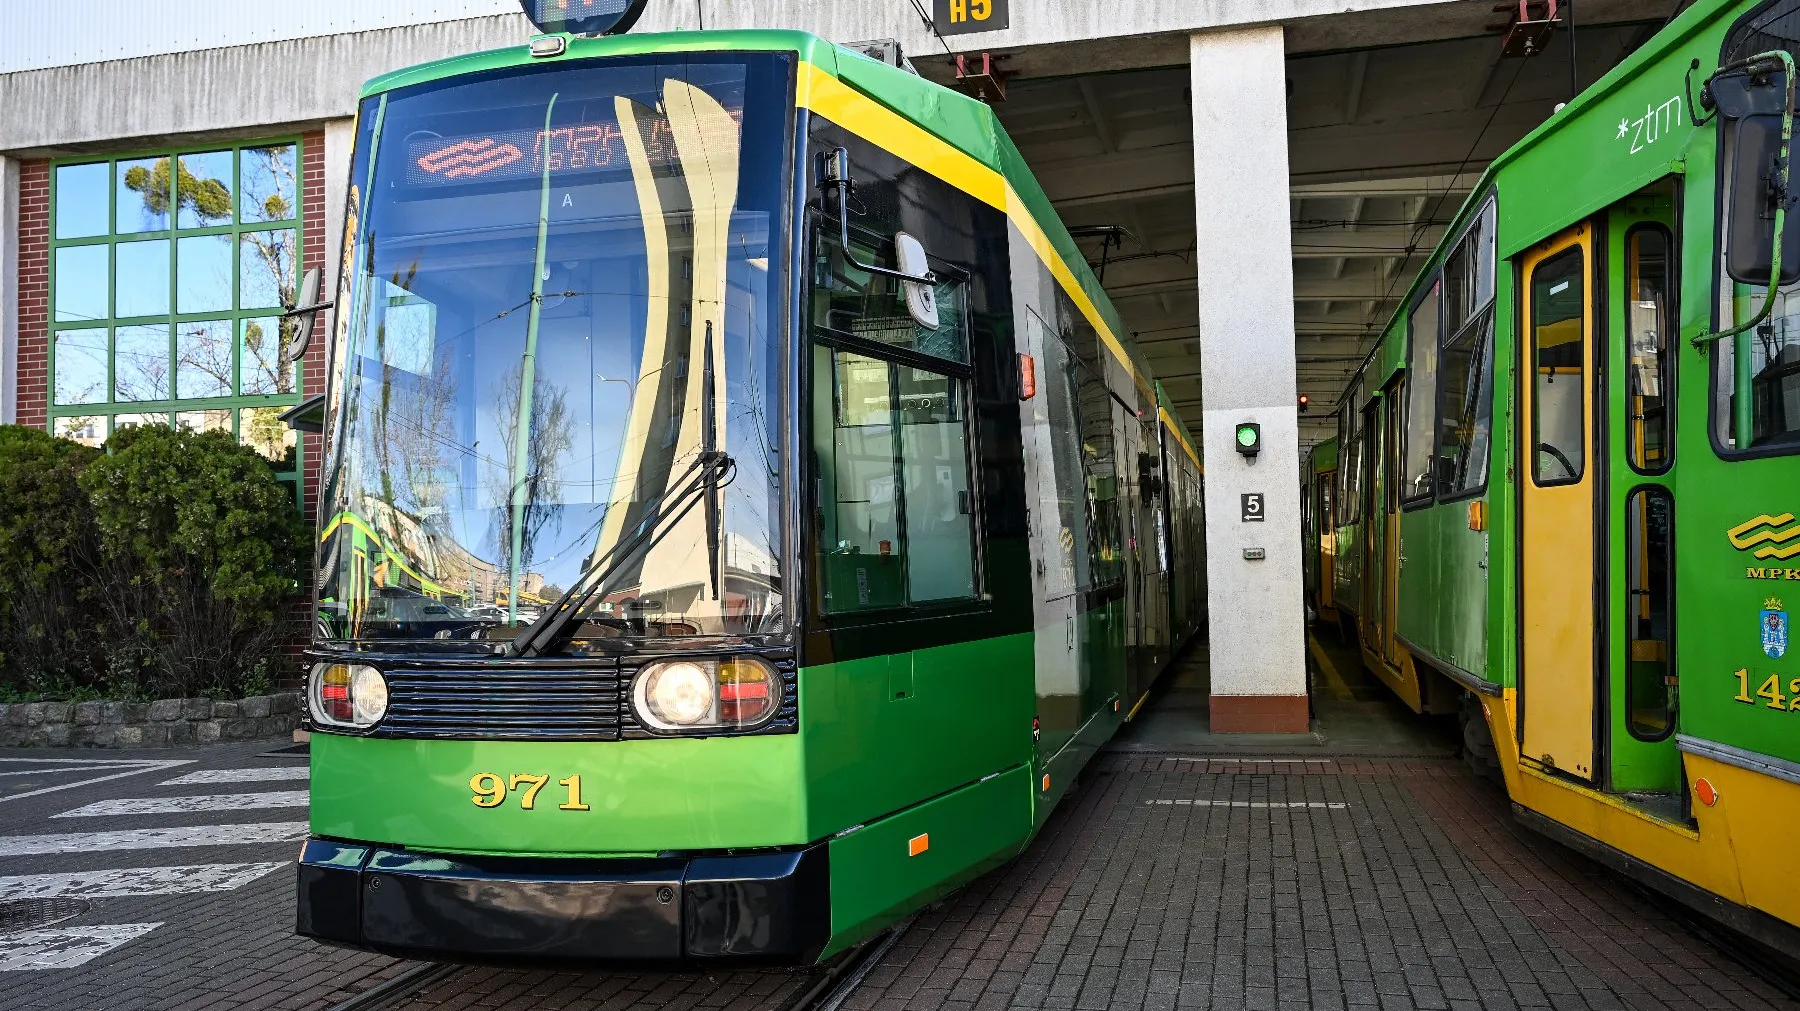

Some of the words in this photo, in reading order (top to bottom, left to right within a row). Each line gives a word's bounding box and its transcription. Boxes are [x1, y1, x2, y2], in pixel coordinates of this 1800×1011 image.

[561, 193, 573, 207] A
[1247, 495, 1260, 513] 5
[1746, 567, 1800, 580] MPK
[469, 772, 590, 811] 971
